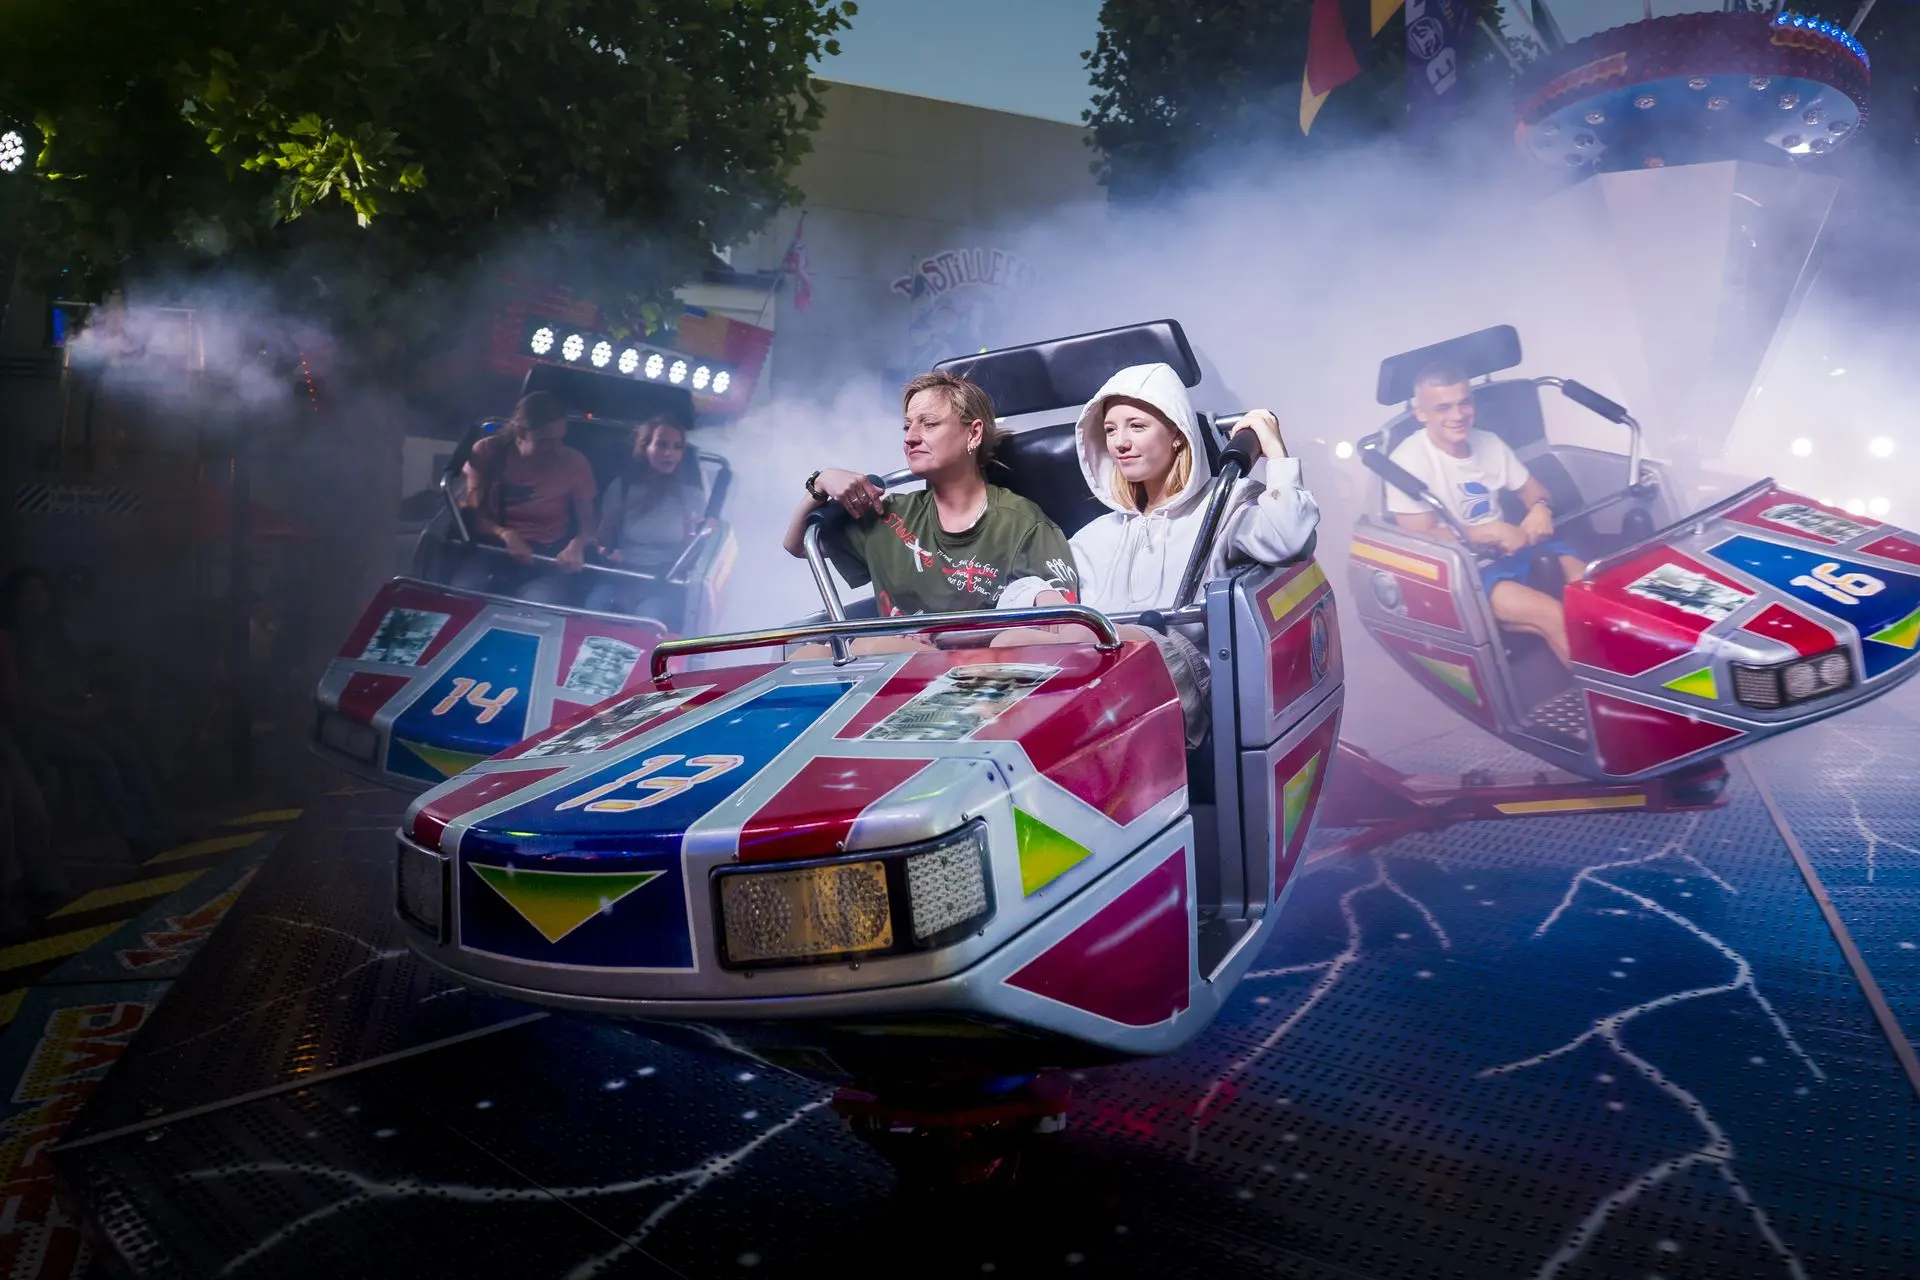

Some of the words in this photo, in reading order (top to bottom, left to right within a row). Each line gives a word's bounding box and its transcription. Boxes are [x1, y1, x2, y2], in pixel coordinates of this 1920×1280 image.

[1789, 562, 1887, 605] 16
[431, 677, 519, 725] 14
[554, 754, 745, 813] 13
